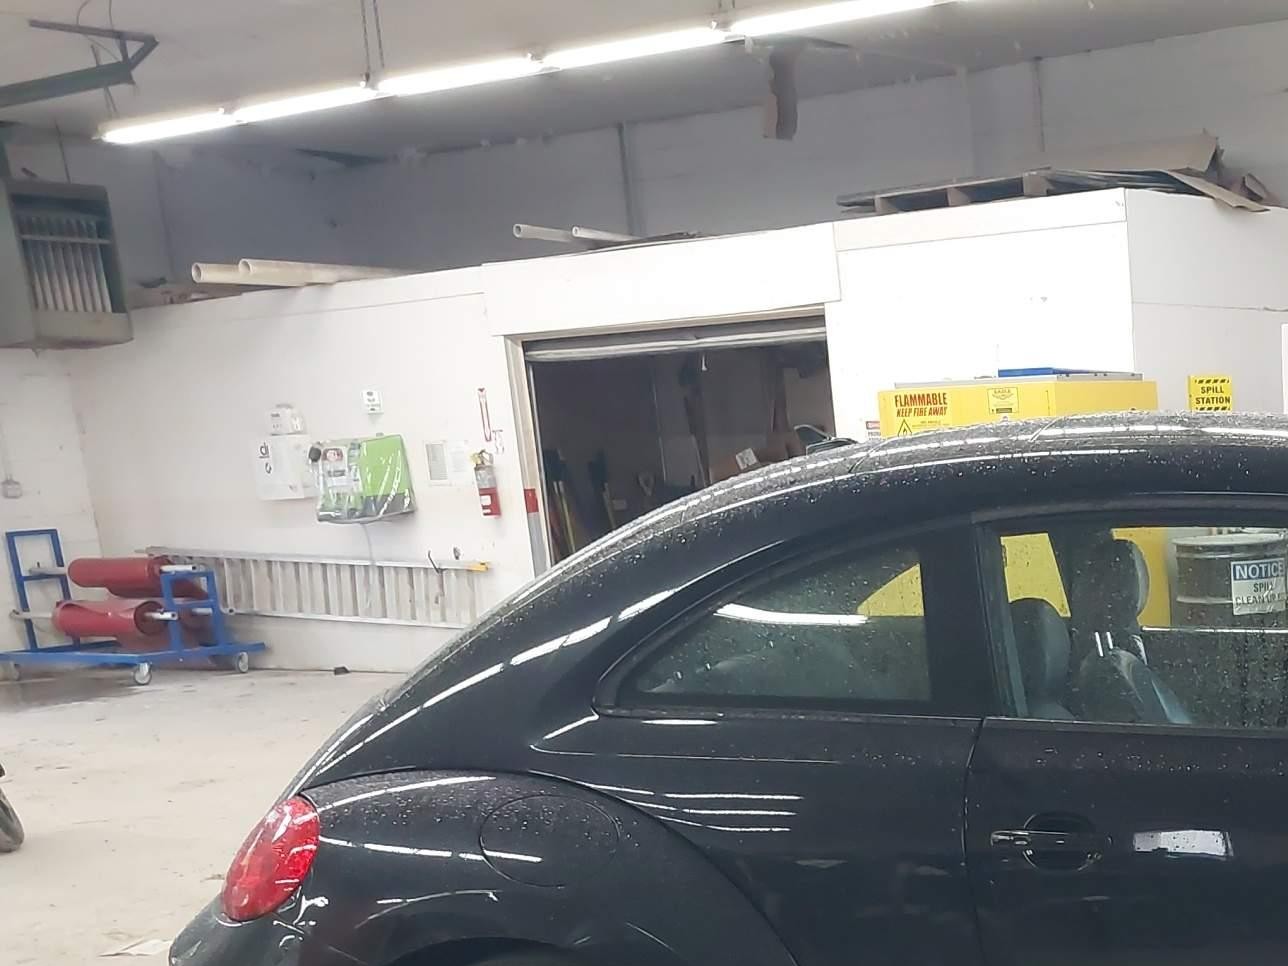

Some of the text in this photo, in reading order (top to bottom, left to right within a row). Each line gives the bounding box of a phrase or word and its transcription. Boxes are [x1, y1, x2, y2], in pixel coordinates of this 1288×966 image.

[1200, 385, 1225, 395] SPILL
[894, 392, 948, 408] FLAMMABLE
[1195, 396, 1231, 405] STATION
[896, 406, 948, 418] KEEP FIRE AWAY
[1235, 560, 1285, 580] NOTICE
